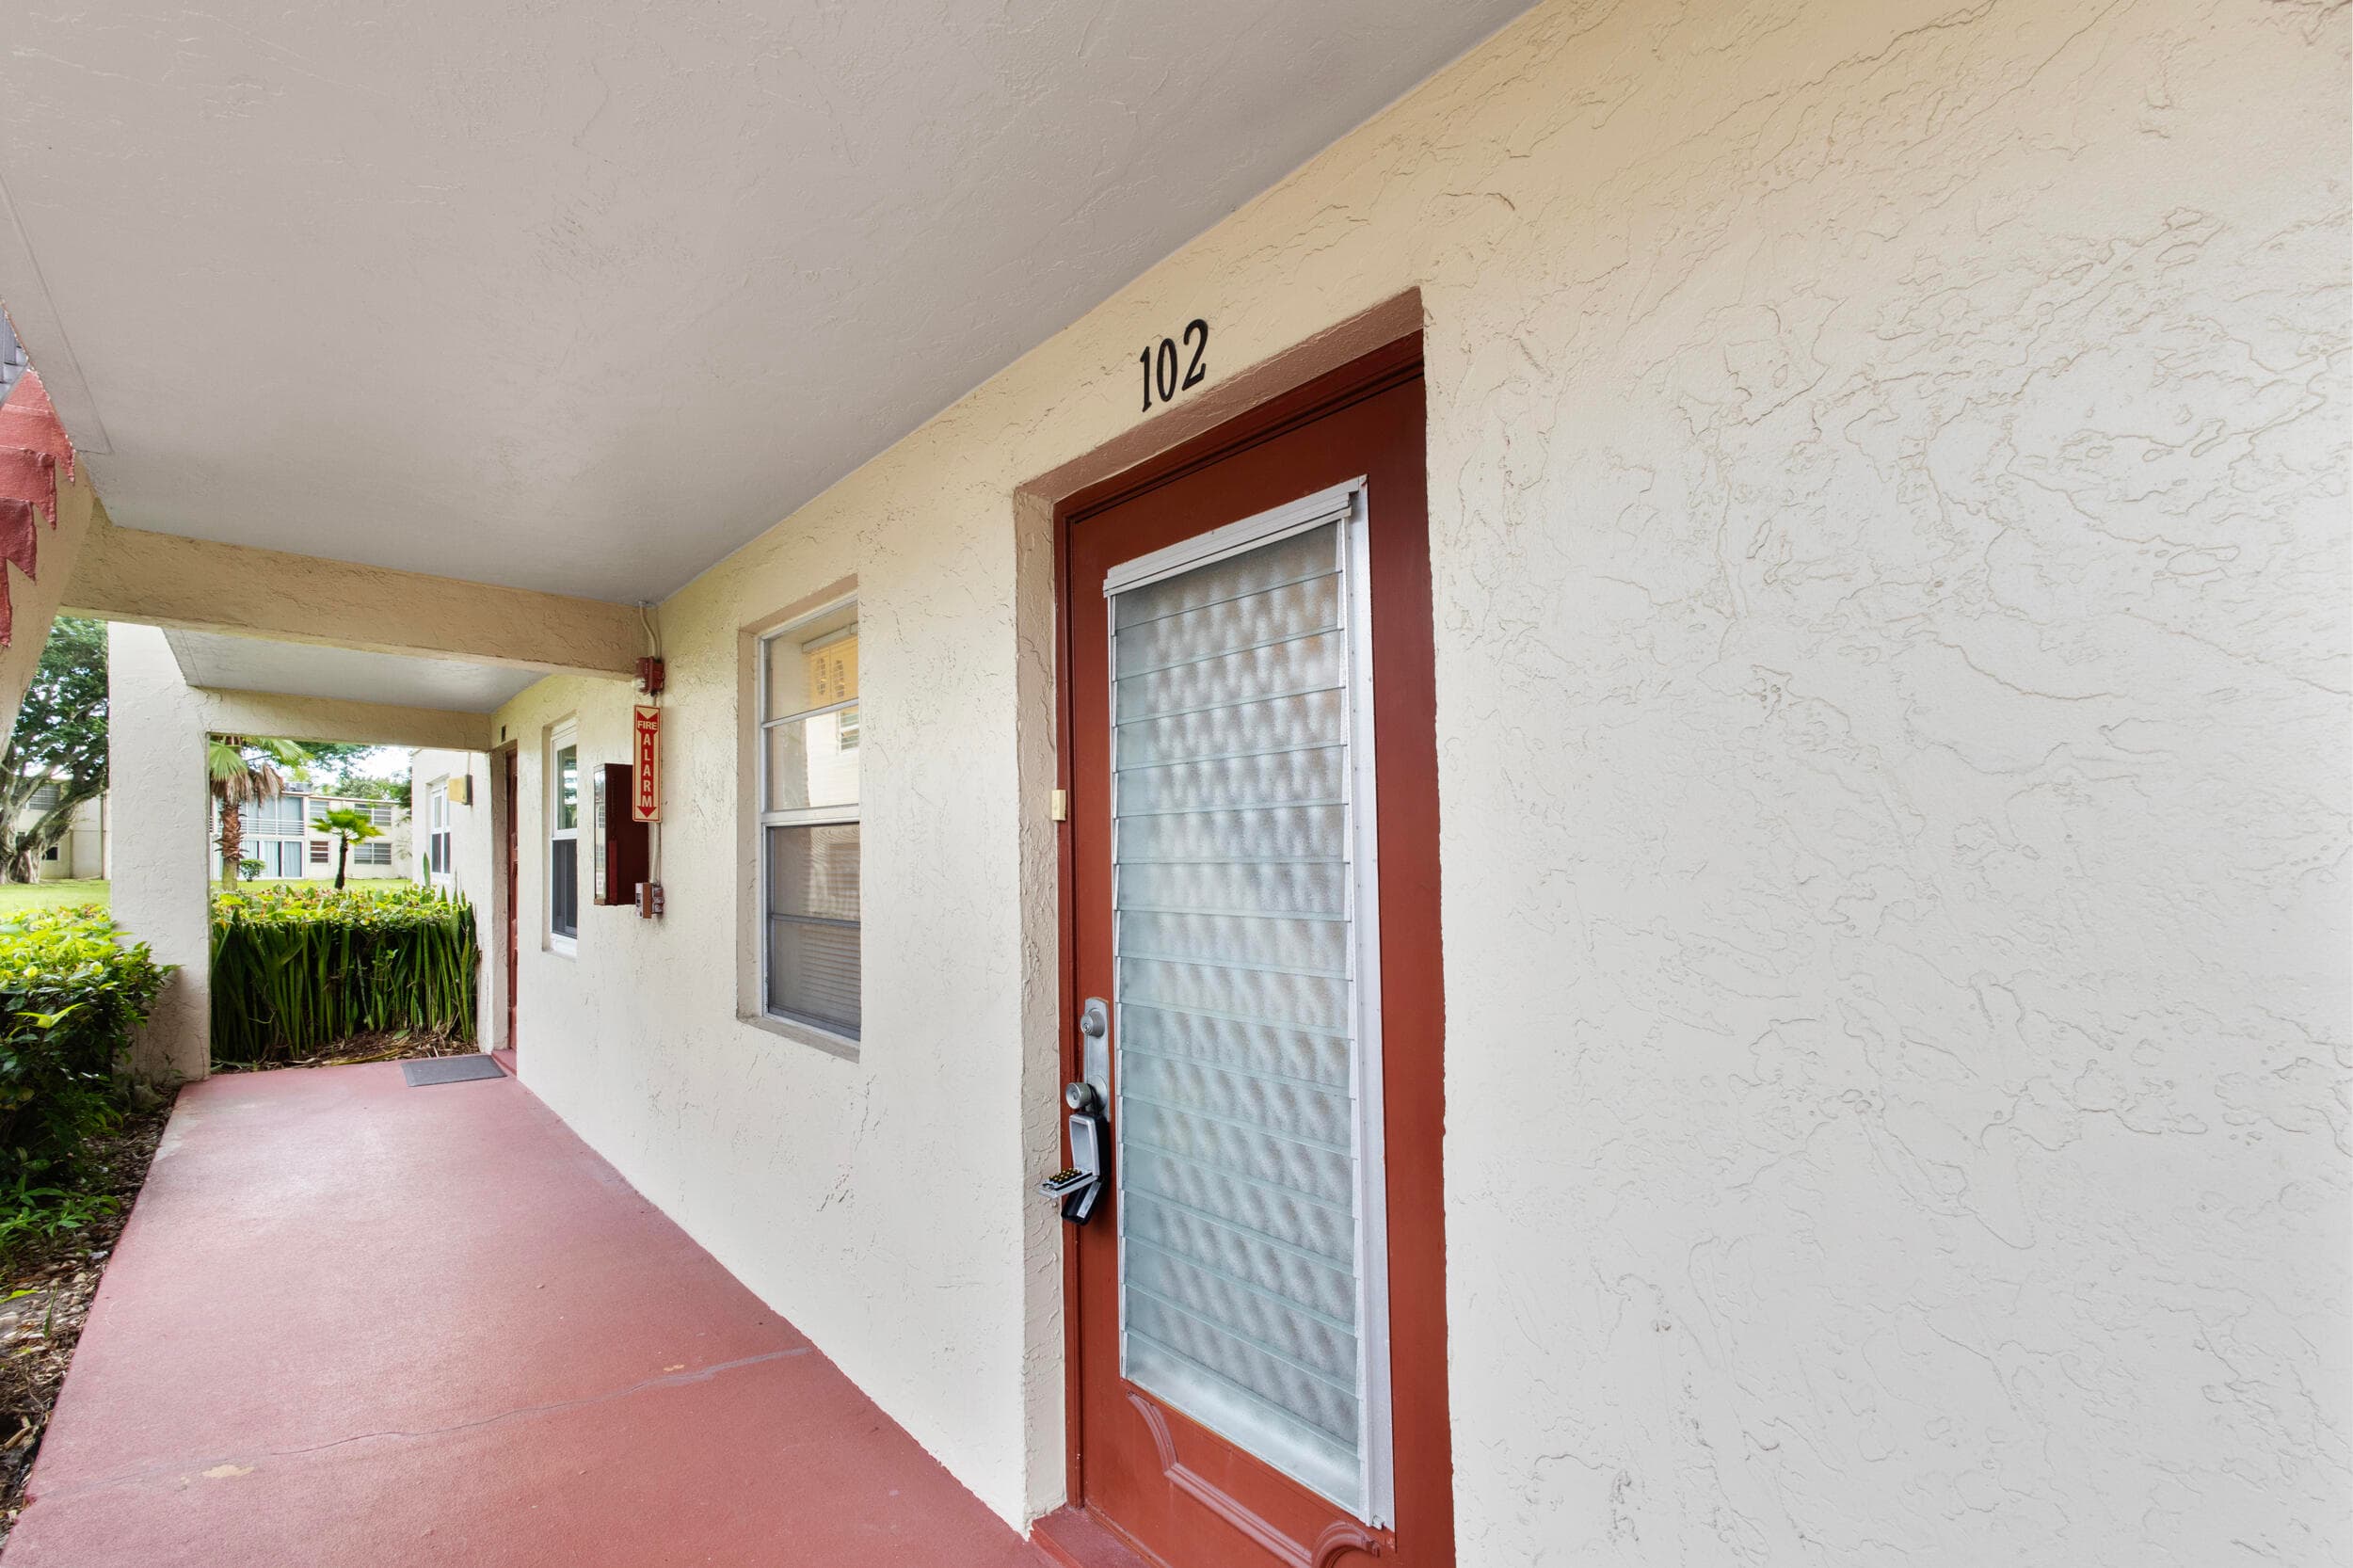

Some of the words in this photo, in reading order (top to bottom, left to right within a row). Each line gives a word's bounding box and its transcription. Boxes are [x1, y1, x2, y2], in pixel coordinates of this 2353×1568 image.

[1140, 319, 1209, 412] 102
[637, 720, 658, 730] FIRE
[642, 733, 652, 808] ALARM
